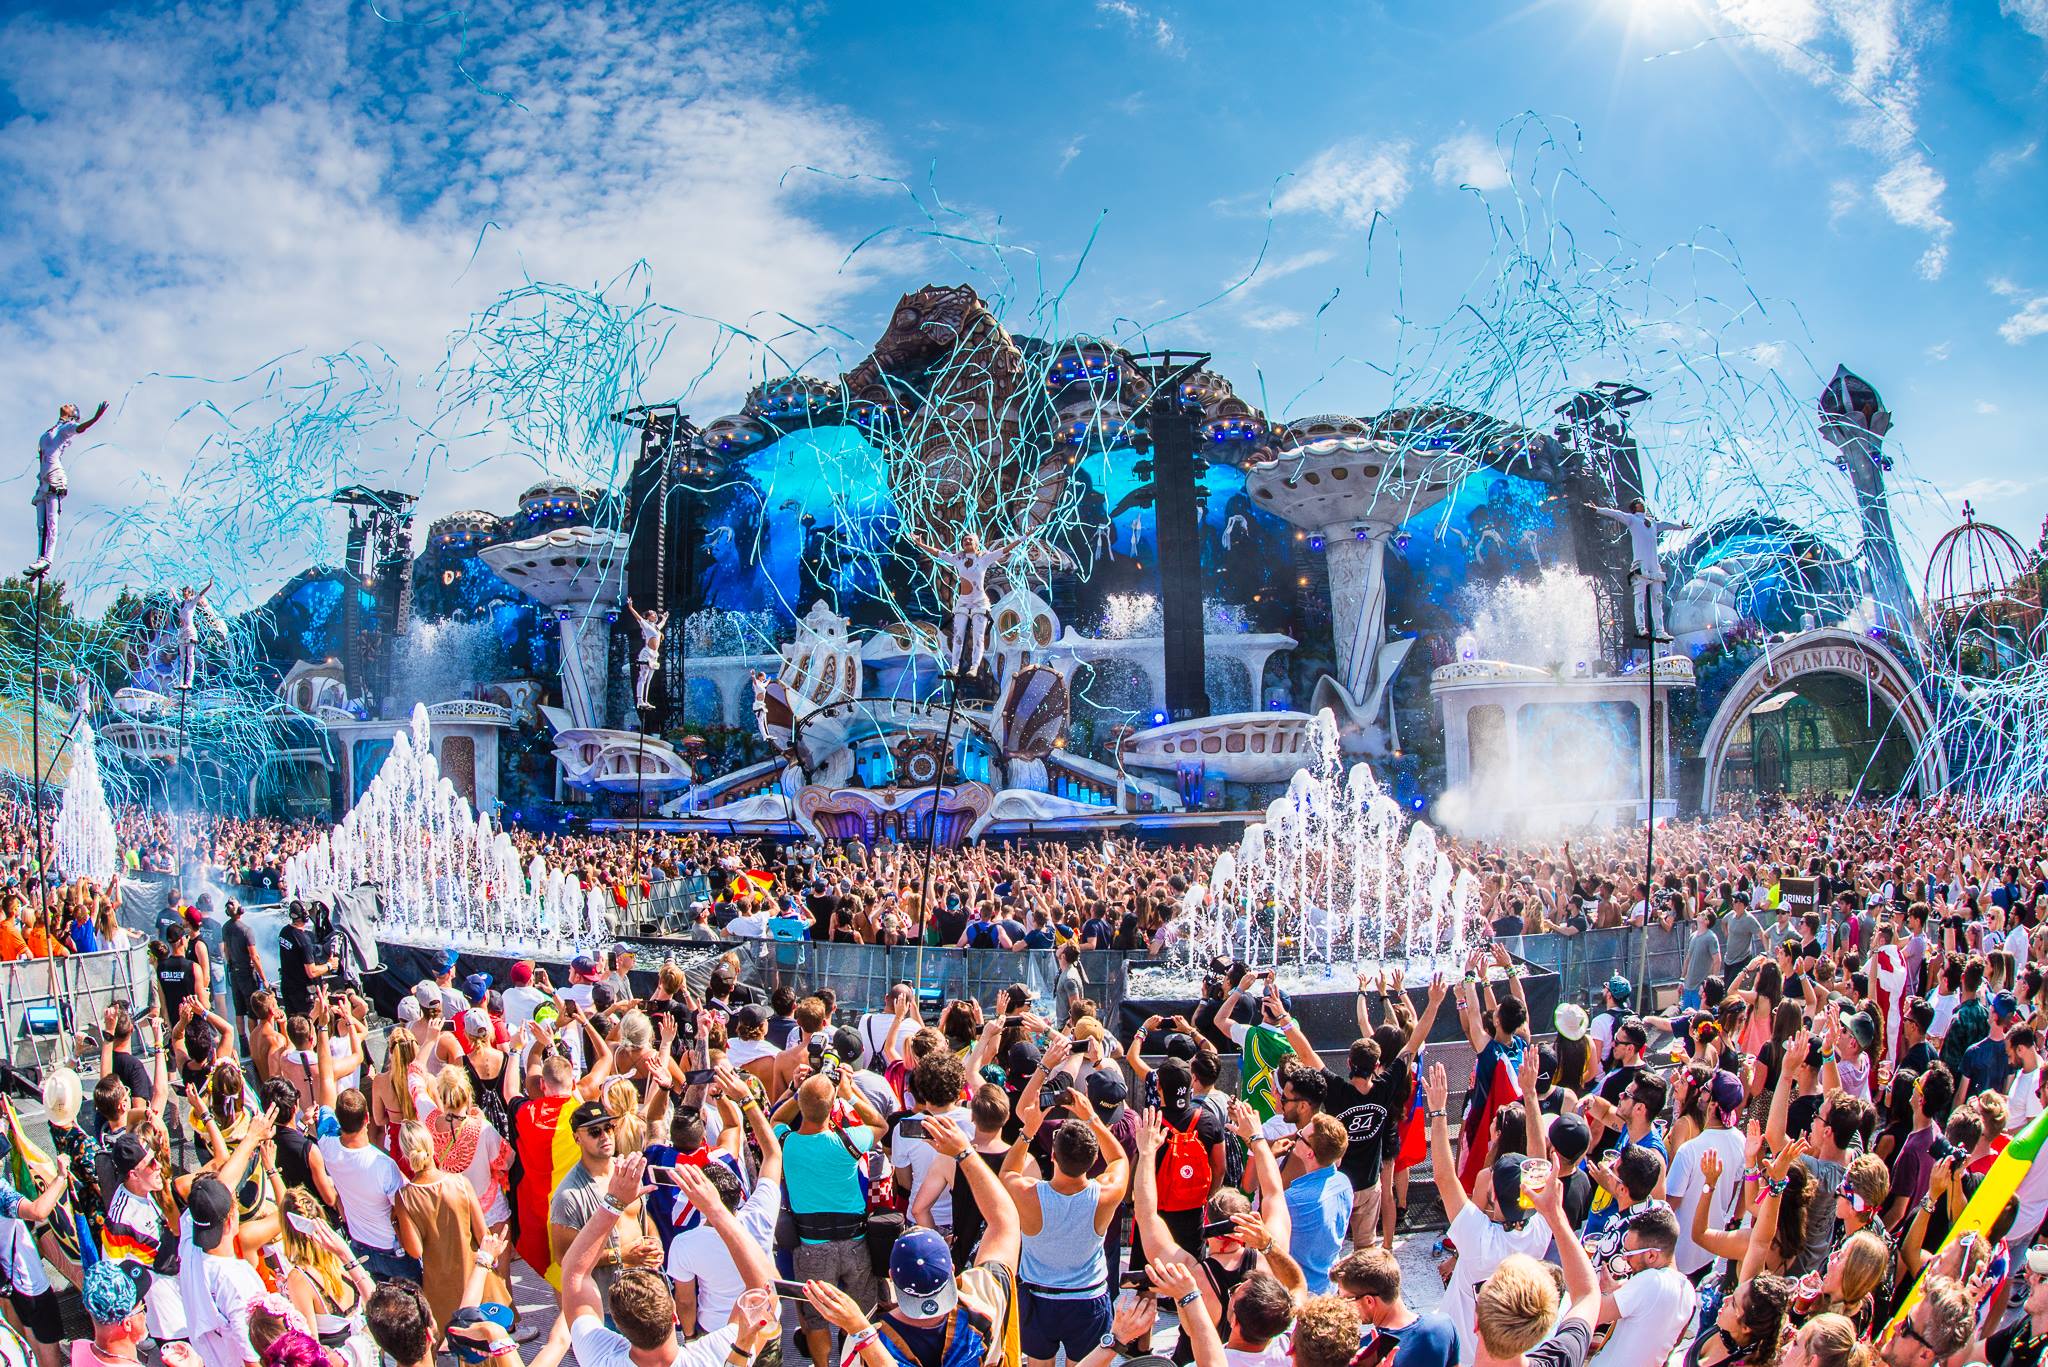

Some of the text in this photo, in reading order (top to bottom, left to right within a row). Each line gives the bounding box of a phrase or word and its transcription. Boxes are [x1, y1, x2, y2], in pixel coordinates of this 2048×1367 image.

[1780, 649, 1862, 678] PLANAXIS
[1782, 893, 1812, 905] DRINKS
[1348, 1115, 1373, 1131] 84
